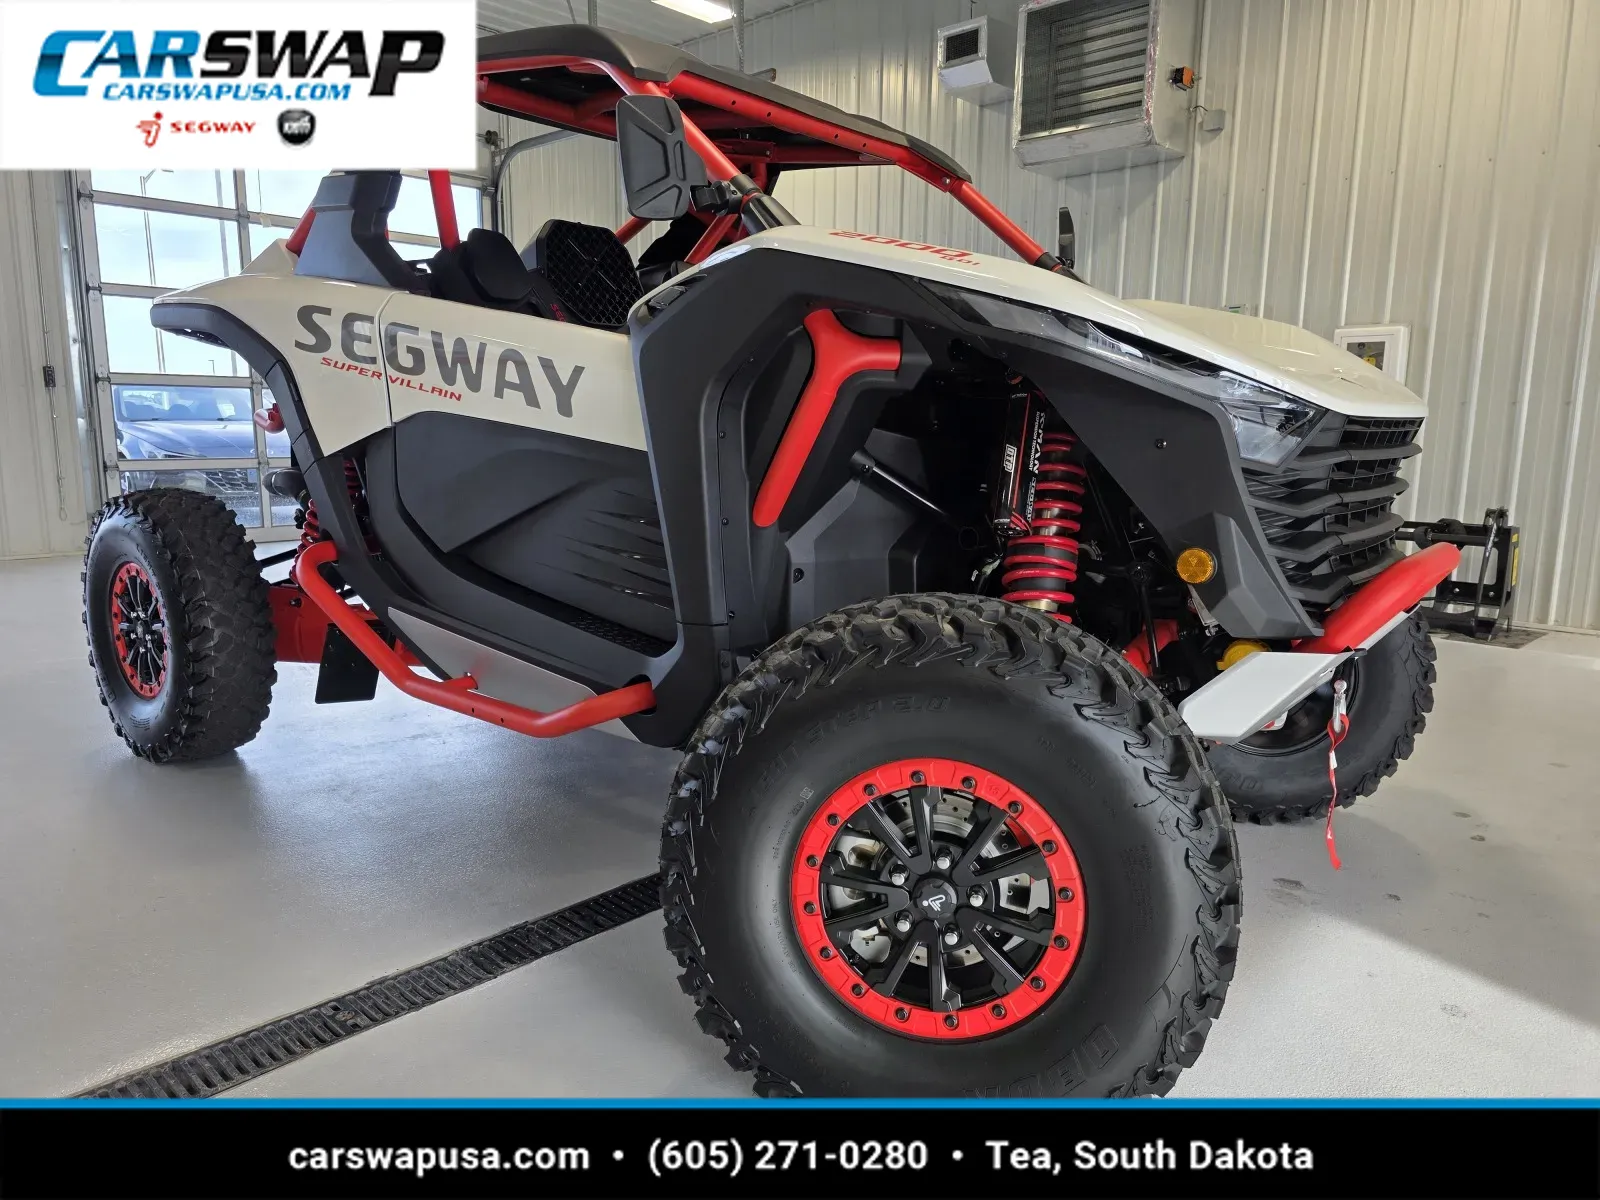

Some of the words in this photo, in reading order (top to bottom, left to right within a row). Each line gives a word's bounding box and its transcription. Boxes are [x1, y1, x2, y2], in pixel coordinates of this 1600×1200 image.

[829, 230, 974, 258] 2000
[294, 304, 586, 419] SEGWAY
[320, 356, 383, 381] SUPER
[388, 375, 463, 402] VILLAIN
